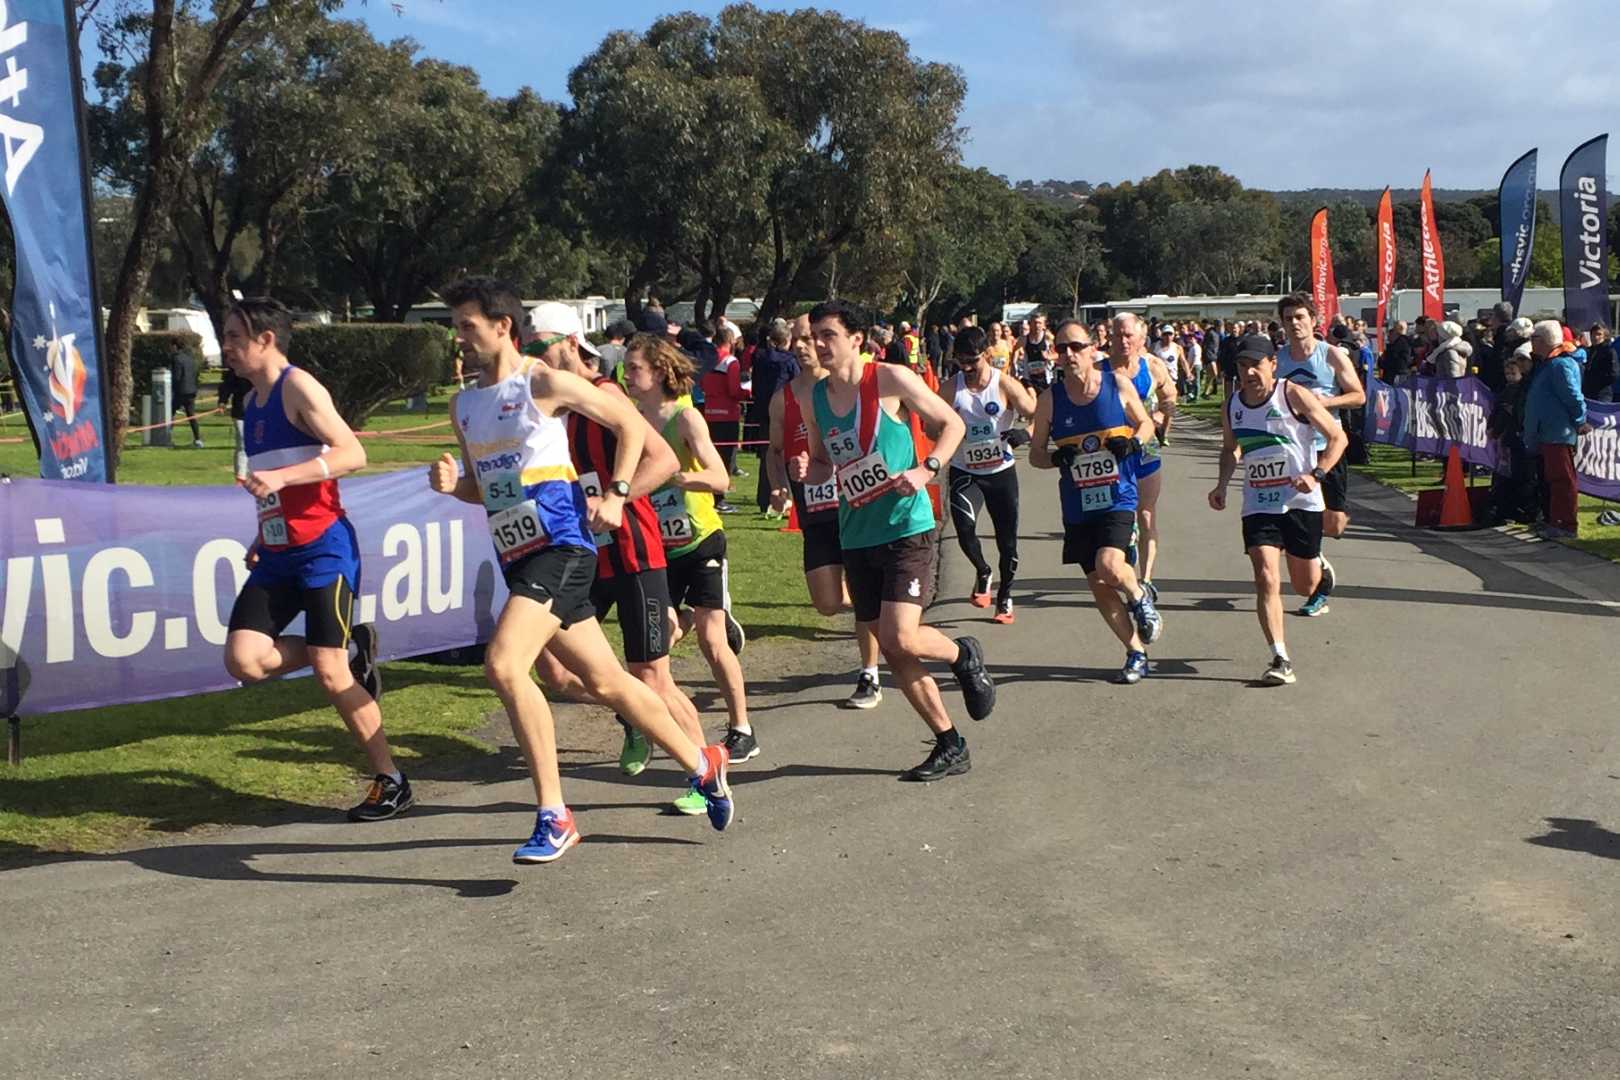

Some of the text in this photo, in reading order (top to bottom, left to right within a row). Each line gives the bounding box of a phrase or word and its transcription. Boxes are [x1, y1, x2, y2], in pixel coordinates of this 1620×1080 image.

[1574, 176, 1602, 290] Victoria
[971, 425, 991, 436] 5-8
[831, 438, 854, 455] 5-6
[967, 446, 1001, 462] 1934
[1074, 459, 1114, 478] 1789
[1248, 461, 1286, 478] 2017
[844, 464, 888, 496] 1066
[489, 482, 516, 498] 5-1
[808, 484, 837, 502] 143
[1258, 492, 1280, 503] 5-12
[1085, 493, 1107, 505] 5-11
[494, 516, 537, 548] 1519
